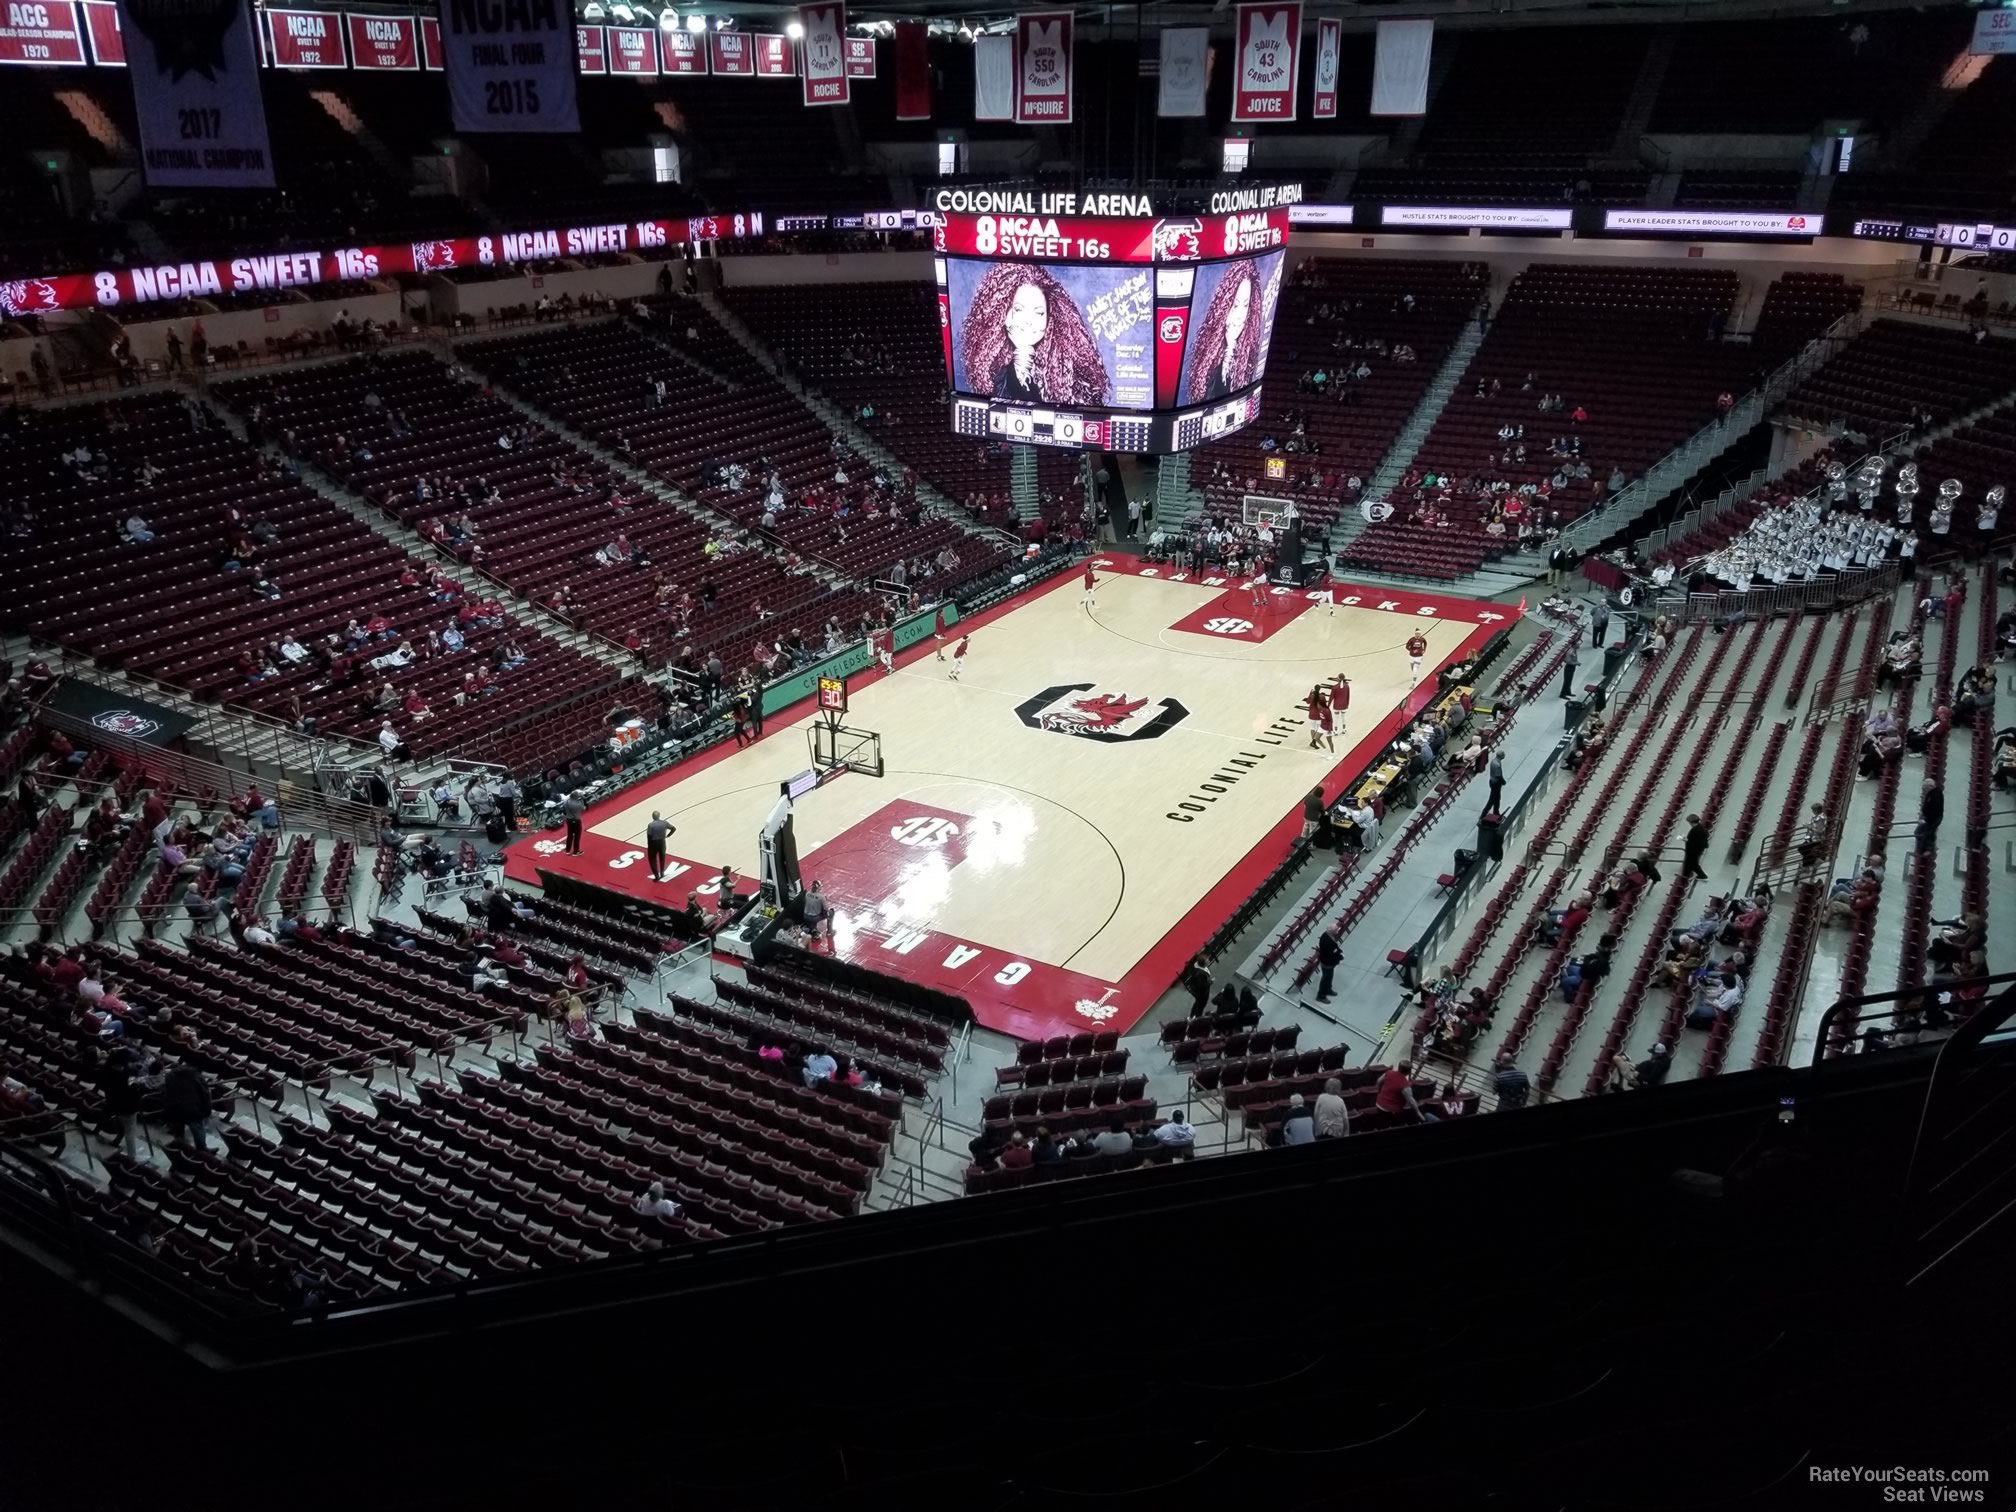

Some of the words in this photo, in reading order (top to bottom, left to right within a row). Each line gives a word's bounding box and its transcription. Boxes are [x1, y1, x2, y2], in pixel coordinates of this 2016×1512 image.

[9, 3, 49, 28] ACC
[450, 0, 558, 34] NCAA
[287, 16, 326, 37] NCAA
[366, 20, 402, 40] NCAA
[619, 32, 646, 50] NCAA
[671, 32, 696, 50] NCAA
[720, 35, 743, 52] NCAA
[813, 32, 833, 44] SOUTH
[1254, 39, 1280, 52] SOUTH
[22, 44, 49, 58] 1970
[300, 51, 321, 63] 1972
[472, 44, 508, 67] FINAL
[511, 43, 545, 65] FOUR
[819, 44, 829, 58] 11
[852, 42, 865, 57] SEC
[1033, 46, 1057, 58] SOUTH
[378, 55, 396, 65] 1973
[811, 56, 838, 71] CAROLINA
[1259, 53, 1275, 67] 43
[1028, 72, 1061, 87] CAROLINA
[1247, 67, 1285, 83] CAROLINA
[485, 79, 540, 115] 2015
[813, 83, 840, 97] ROCHE
[1247, 97, 1282, 112] JOYCE
[178, 108, 222, 139] 2017
[147, 149, 202, 170] NATIONAL
[204, 149, 265, 170] CHAMPION
[936, 190, 1036, 214] COLONIAL
[1041, 193, 1077, 215] LIFE
[1081, 194, 1153, 217] ARENA
[1211, 188, 1259, 214] COLONIAL
[1260, 187, 1276, 208] LIFE
[1276, 183, 1303, 206] ARENA
[733, 214, 746, 238] 8
[886, 215, 895, 226] 0
[922, 214, 932, 225] 0
[1000, 218, 1061, 237] NCAA
[1239, 211, 1269, 233] NCAA
[1618, 217, 1646, 225] PLAYER
[1677, 218, 1701, 226] STATS
[1702, 219, 1738, 227] BROUGHT
[1740, 219, 1751, 227] TO
[1752, 220, 1769, 228] YOU
[1770, 220, 1783, 228] BY:
[477, 236, 495, 265] 8
[502, 230, 561, 262] NCAA
[567, 223, 628, 255] SWEET
[635, 221, 667, 247] 16s
[976, 215, 997, 256] 8
[1224, 215, 1239, 255] 8
[1239, 228, 1272, 252] SWEET
[1959, 228, 1969, 243] 0
[1998, 231, 2009, 247] 0
[1000, 236, 1072, 258] SWEET
[1077, 239, 1110, 259] 16s
[94, 272, 120, 306] 8
[131, 262, 223, 302] NCAA
[231, 252, 322, 292] SWEET
[334, 248, 379, 281] 16s
[1014, 419, 1025, 433] 0
[1063, 424, 1074, 438] 0
[1203, 617, 1254, 634] SEC
[821, 679, 842, 692] 25:26
[824, 690, 842, 706] 30
[1166, 752, 1267, 823] COLONIAL
[1255, 717, 1305, 746] LIFE
